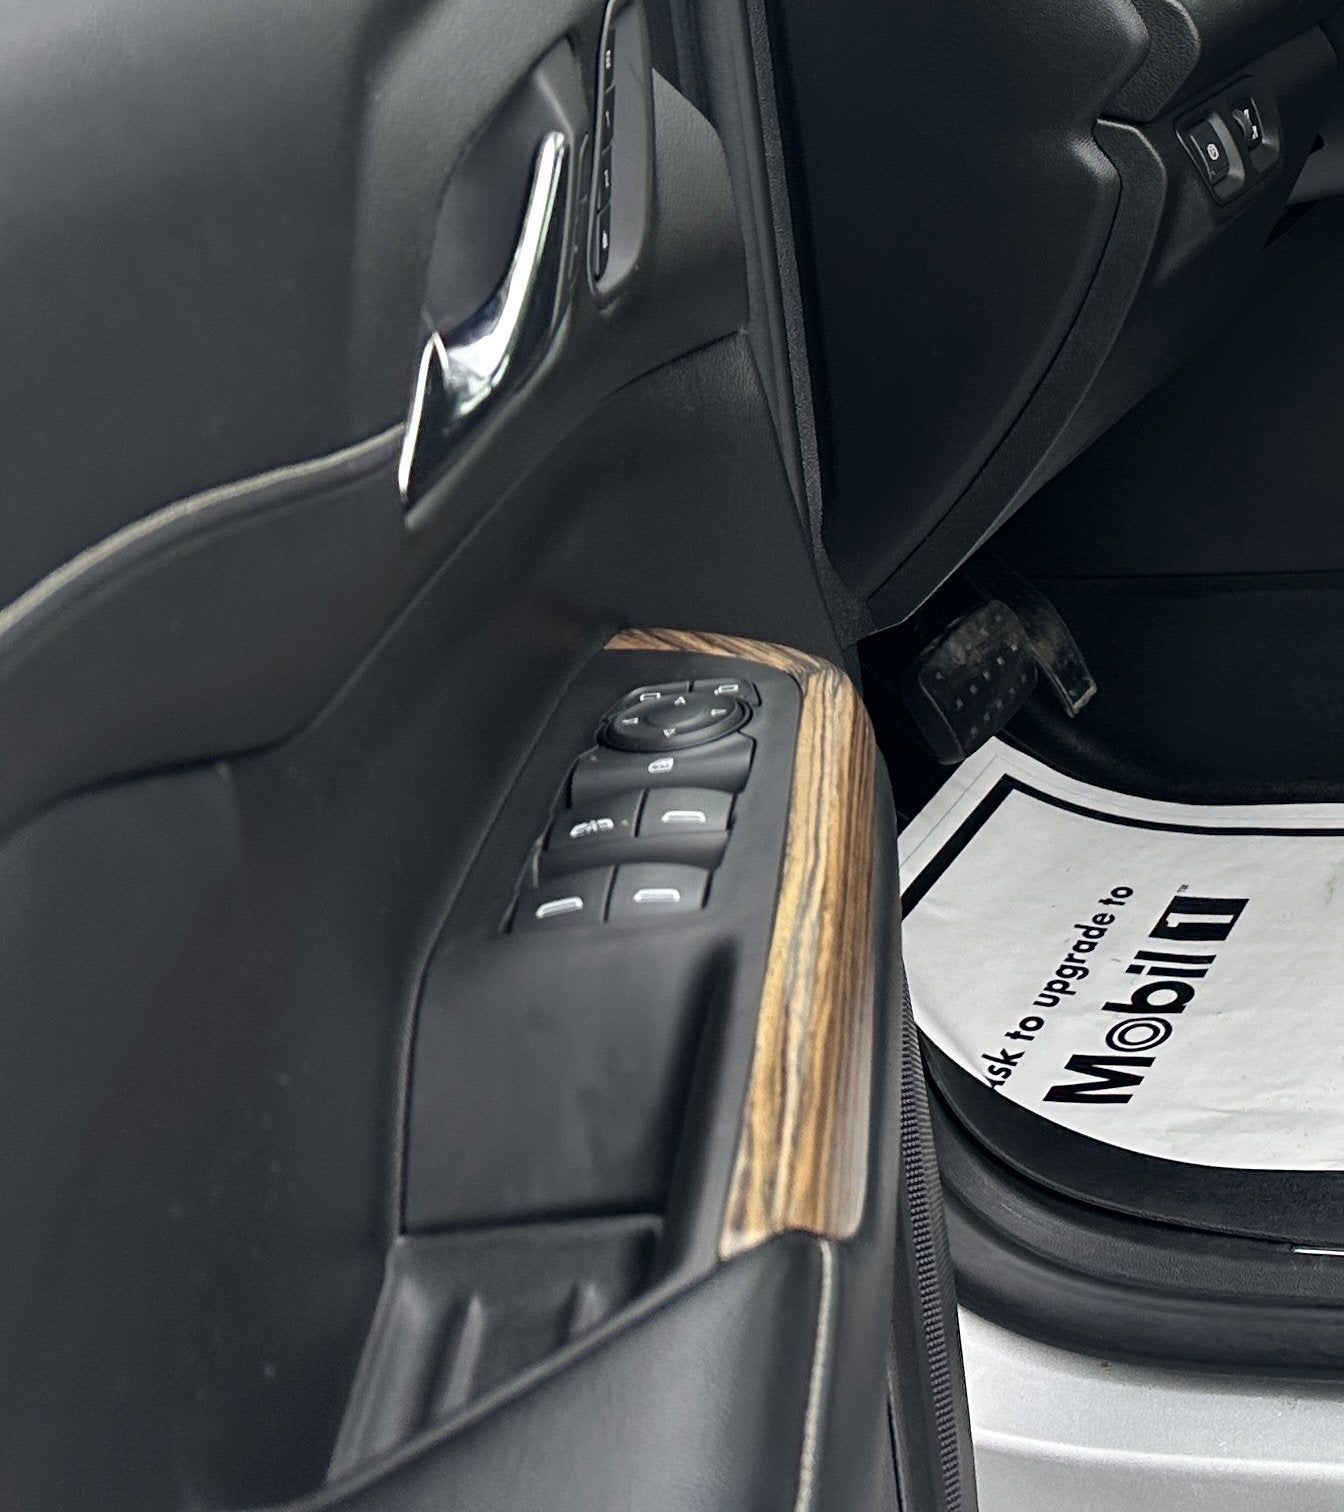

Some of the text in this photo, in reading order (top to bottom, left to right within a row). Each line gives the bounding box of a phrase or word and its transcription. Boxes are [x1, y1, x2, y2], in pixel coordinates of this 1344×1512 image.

[1004, 1016, 1045, 1041] to
[1033, 912, 1116, 1008] upgrade
[1098, 885, 1134, 906] to
[1042, 950, 1217, 1104] Mobil
